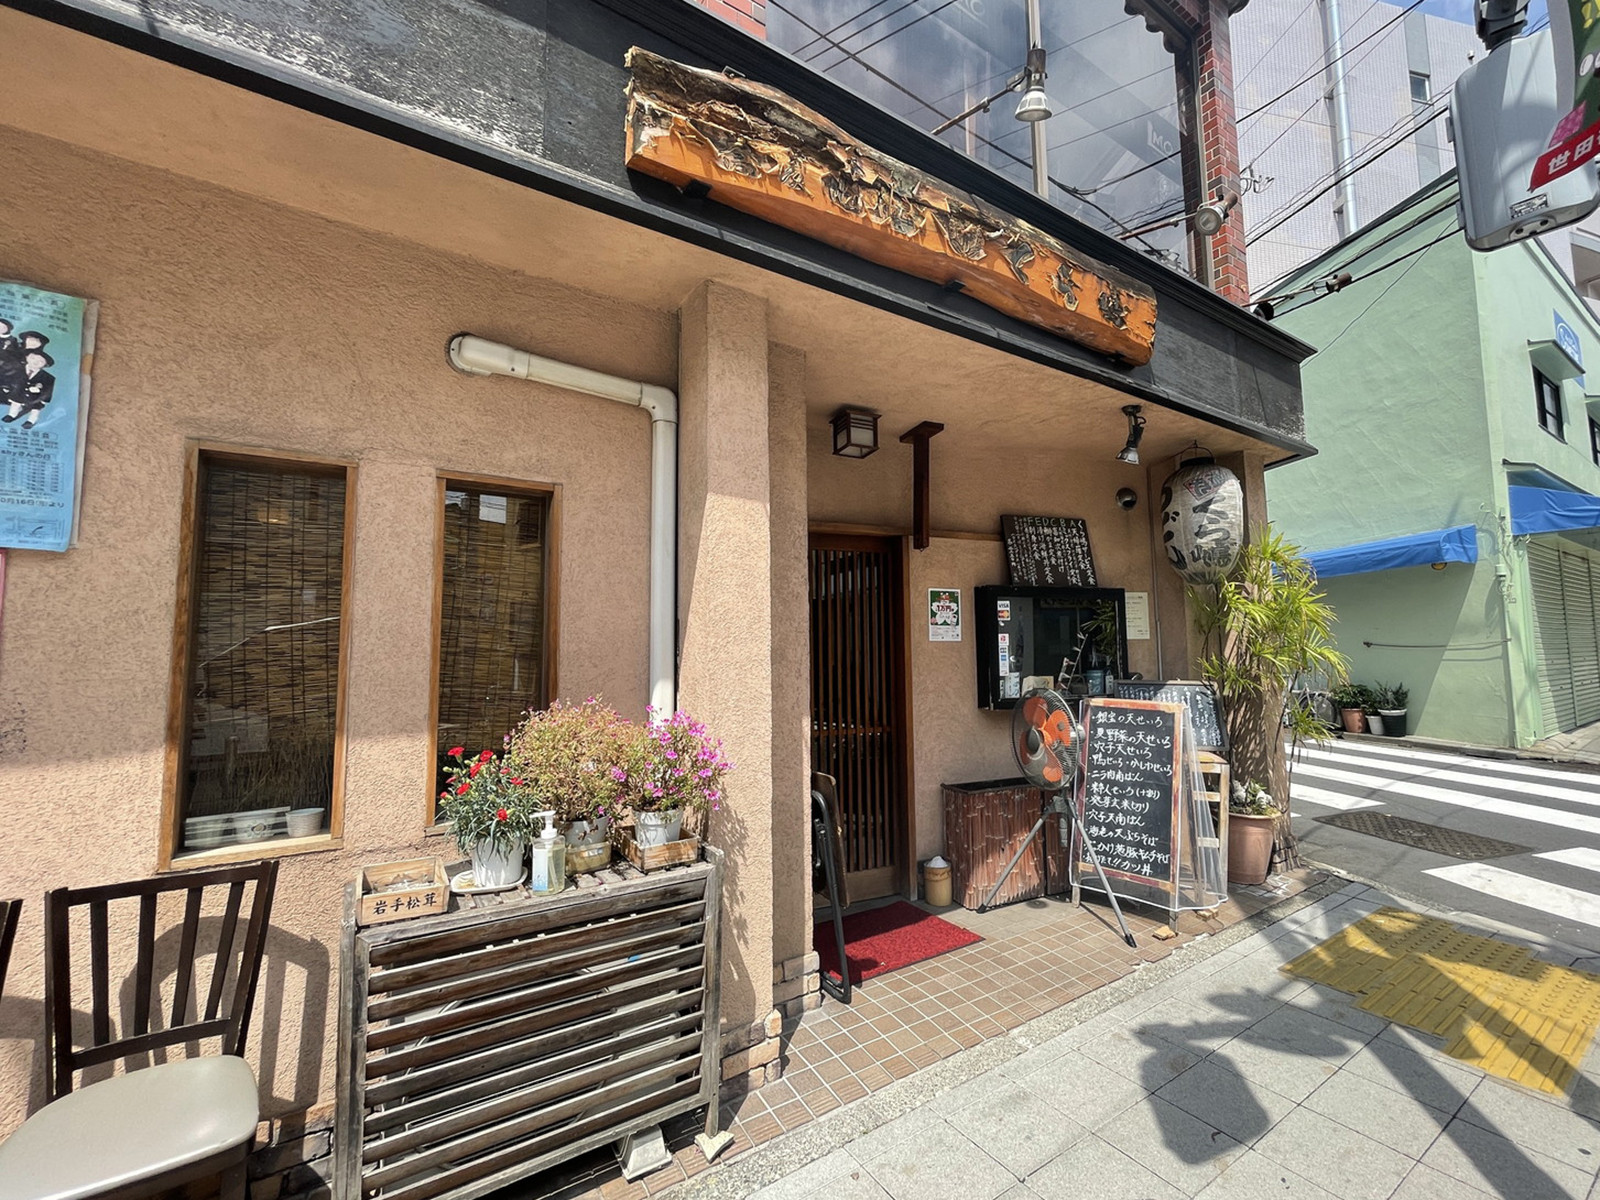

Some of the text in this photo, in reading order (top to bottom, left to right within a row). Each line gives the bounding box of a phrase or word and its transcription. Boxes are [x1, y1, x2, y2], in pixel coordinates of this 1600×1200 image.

[1548, 130, 1600, 175] 世田
[1094, 727, 1173, 749] 夏野菜の天せいろ
[1093, 740, 1153, 759] 穴子天せいろ
[373, 892, 437, 915] 岩手松茸
